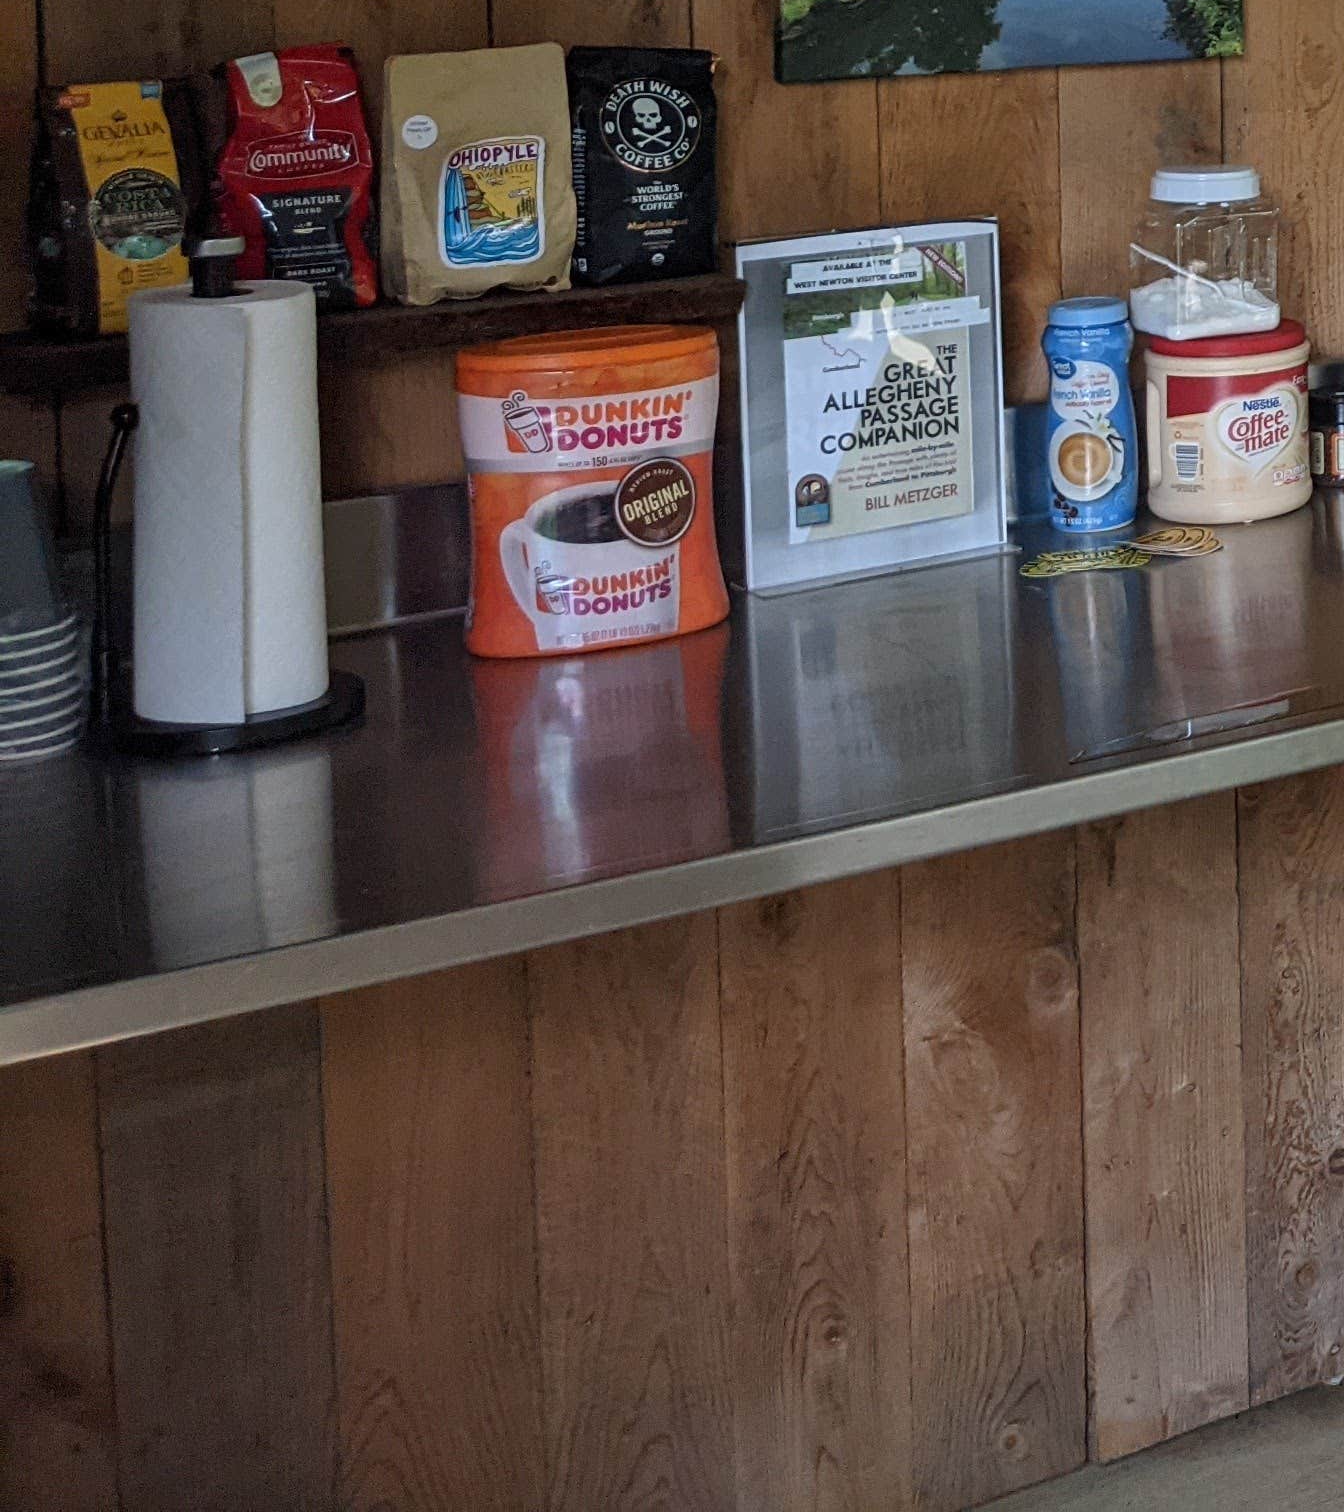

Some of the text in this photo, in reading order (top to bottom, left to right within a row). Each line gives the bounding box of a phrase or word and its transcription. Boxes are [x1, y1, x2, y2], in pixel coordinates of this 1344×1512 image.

[605, 80, 691, 112] DEATH WISH
[249, 143, 352, 172] Community
[450, 143, 538, 167] OHIOPYLE
[616, 143, 674, 169] COFFEE
[272, 194, 342, 208] SIGNATURE
[631, 192, 684, 204] STRONGEST
[636, 183, 680, 195] WORLD'S
[639, 201, 675, 211] COFFEE
[822, 259, 864, 273] AVAILABLE
[794, 280, 817, 289] WEST
[818, 276, 854, 288] NEWTON
[936, 344, 958, 355] THE
[884, 355, 957, 383] GREAT
[555, 389, 694, 426] DUNKIN'
[823, 375, 957, 414] ALLEGHENY
[1052, 388, 1078, 401] rench
[860, 395, 959, 428] PASSAGE
[557, 415, 684, 452] DONUTS
[820, 416, 960, 455] COMPANION
[1244, 424, 1290, 454] mate
[591, 456, 607, 467] 150
[623, 479, 690, 523] ORIGINAL
[865, 483, 959, 511] BILL METZGER
[644, 502, 679, 526] BLEND
[572, 553, 675, 596] DUNKIN'
[573, 577, 672, 616] DONUTS
